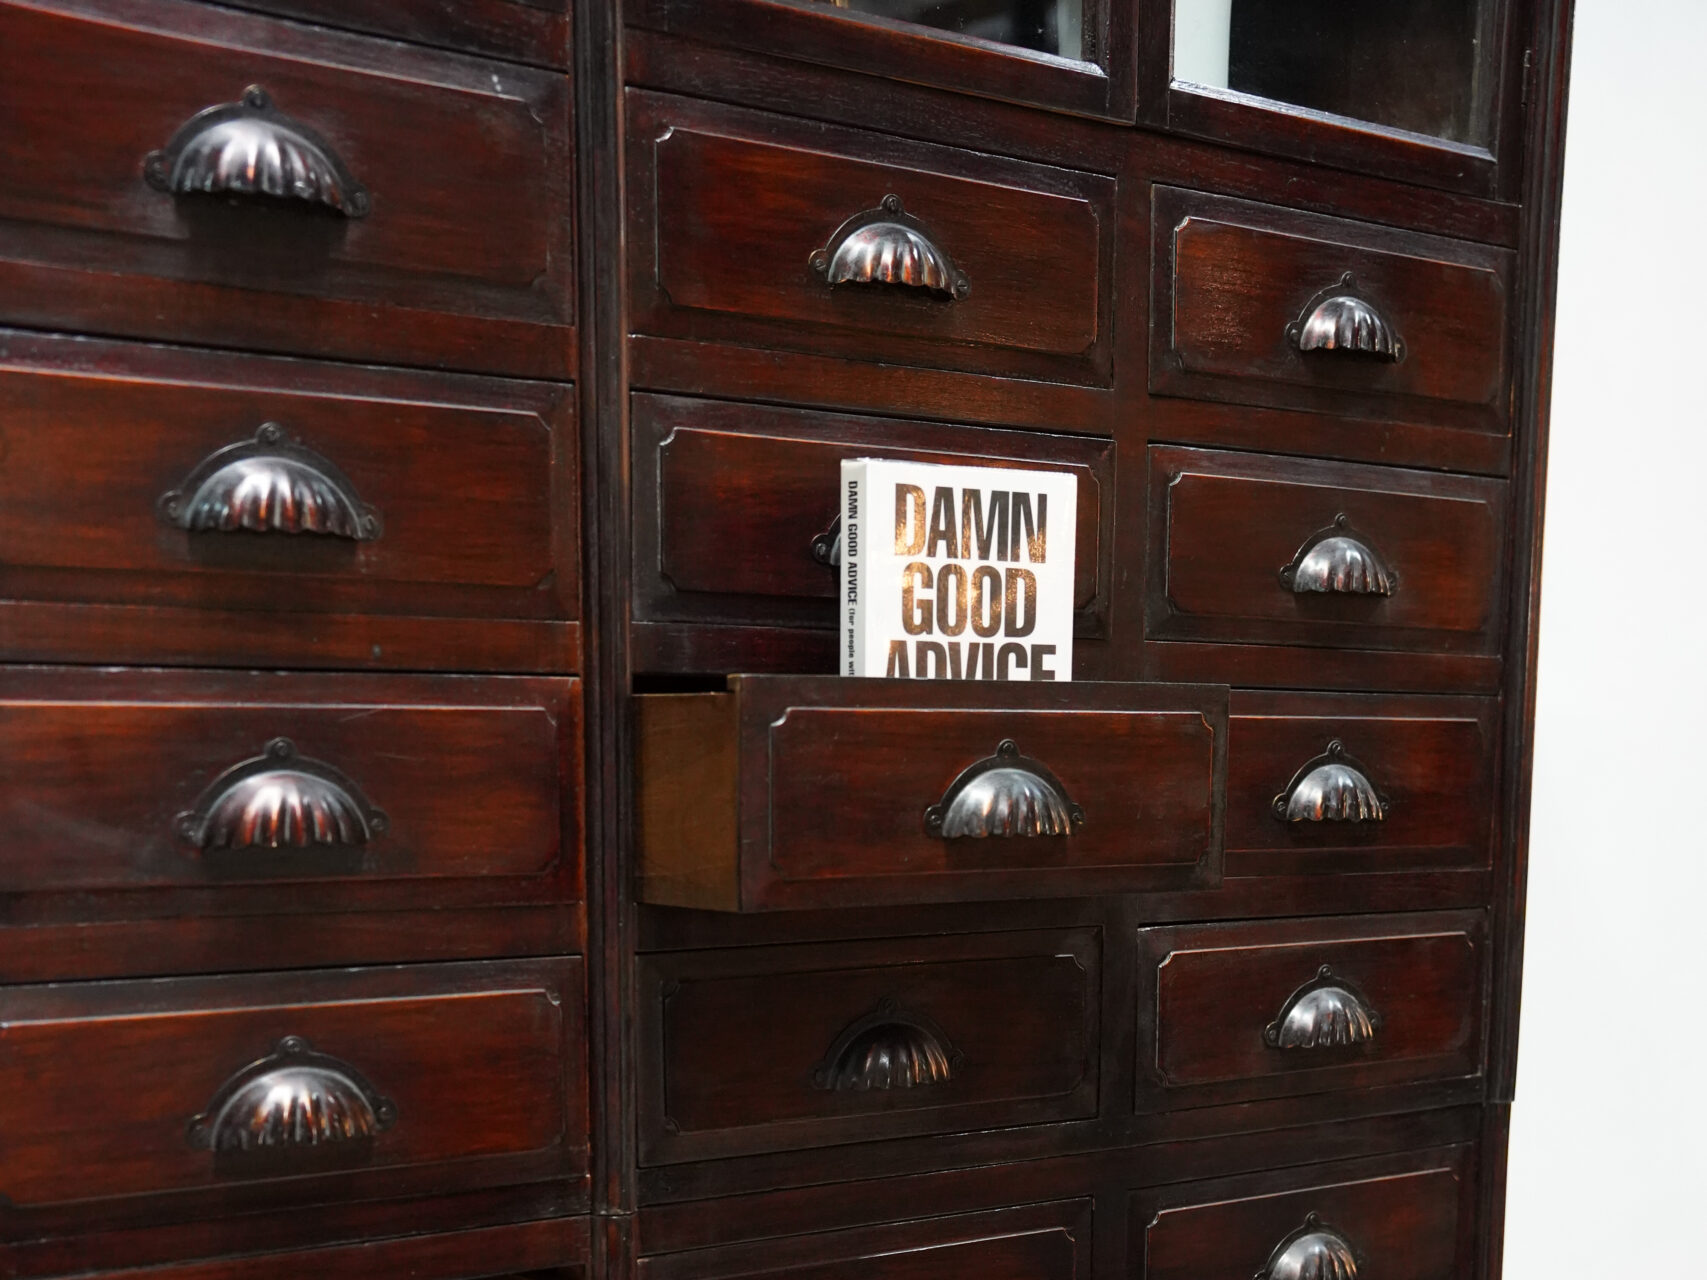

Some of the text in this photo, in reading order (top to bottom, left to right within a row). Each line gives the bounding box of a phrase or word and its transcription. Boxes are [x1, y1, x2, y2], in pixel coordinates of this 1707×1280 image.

[848, 481, 858, 520] DAMN
[848, 525, 858, 557] GOOD
[895, 483, 1047, 563] DAMN
[848, 562, 858, 606] ADVICE
[902, 562, 1037, 638] GOOD
[886, 640, 1056, 681] ADVICE
